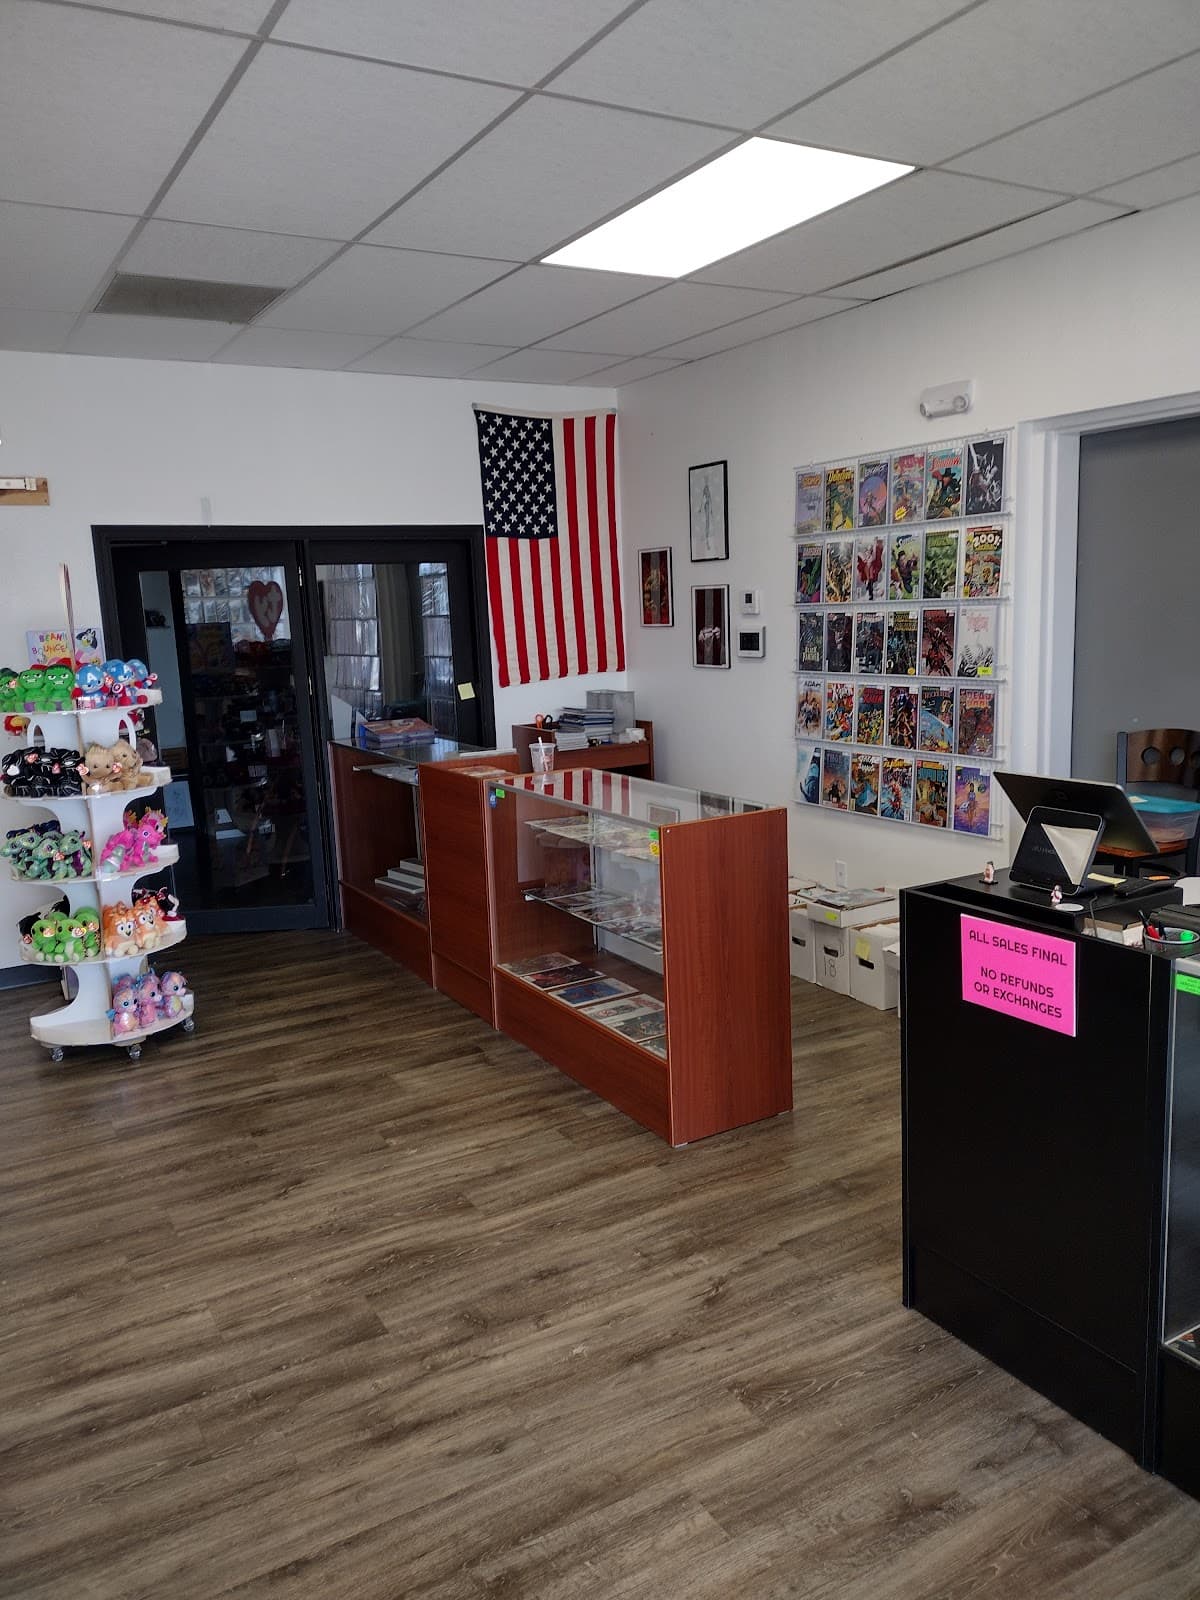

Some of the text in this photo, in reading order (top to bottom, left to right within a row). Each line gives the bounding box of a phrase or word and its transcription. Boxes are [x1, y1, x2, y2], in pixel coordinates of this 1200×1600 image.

[969, 929, 1068, 966] ALL SALES FINAL
[974, 981, 1062, 1018] OR EXCHANGES
[980, 966, 1054, 998] NO REFUNDS
